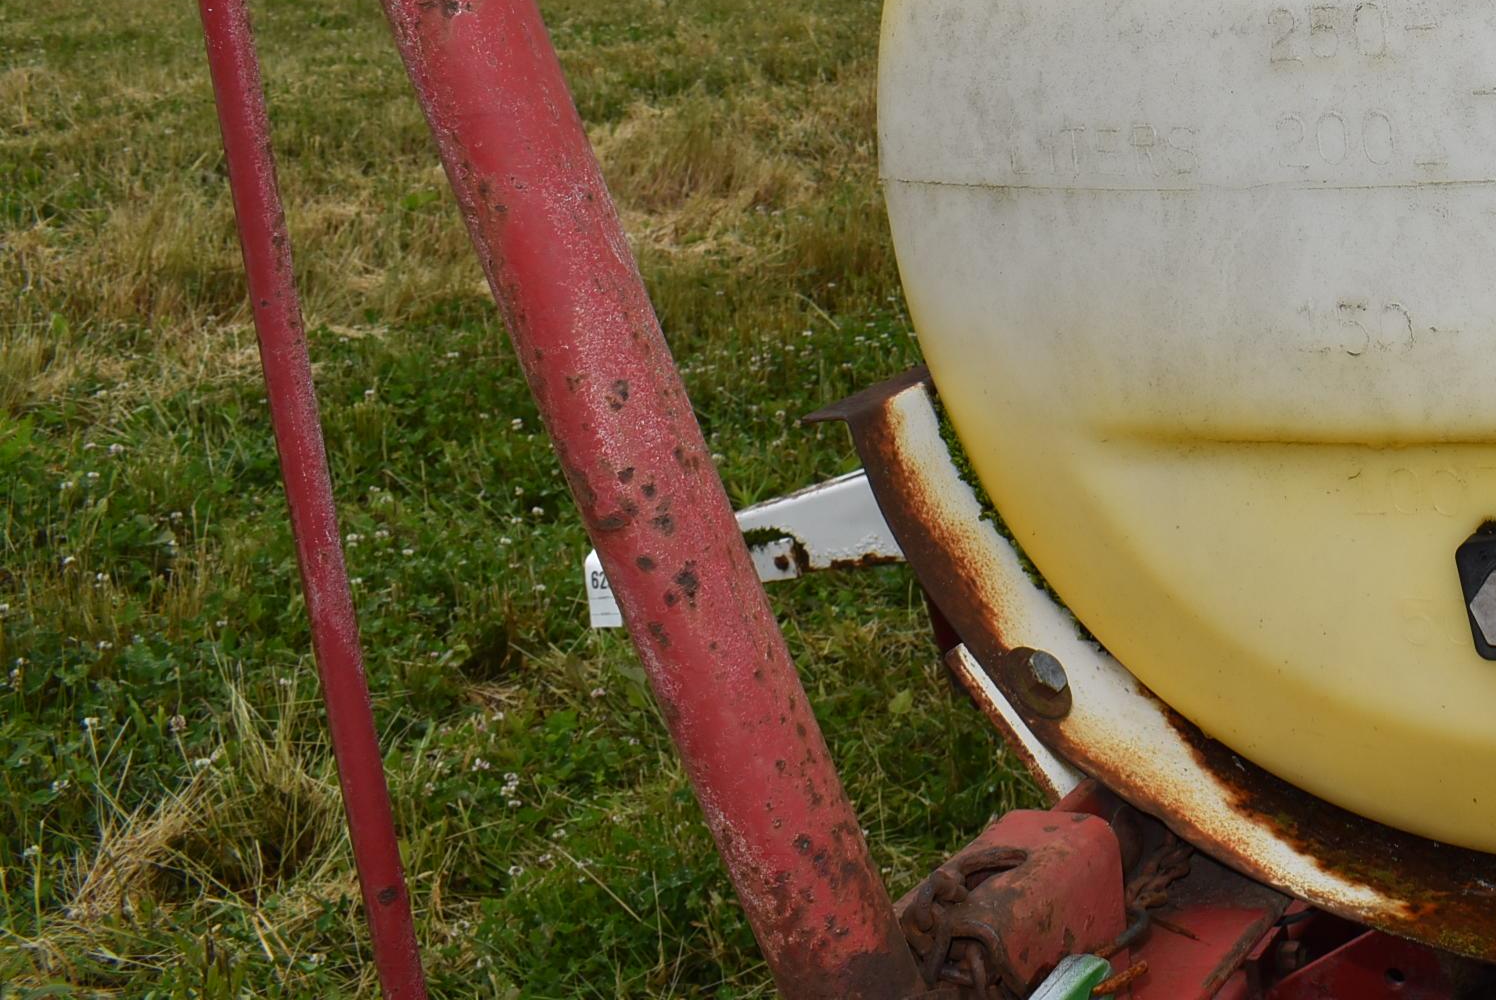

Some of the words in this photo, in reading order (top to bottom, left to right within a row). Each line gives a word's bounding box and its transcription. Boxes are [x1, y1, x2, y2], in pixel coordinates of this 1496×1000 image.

[1266, 3, 1388, 65] 250
[1274, 108, 1394, 169] 200
[1298, 300, 1414, 357] 150
